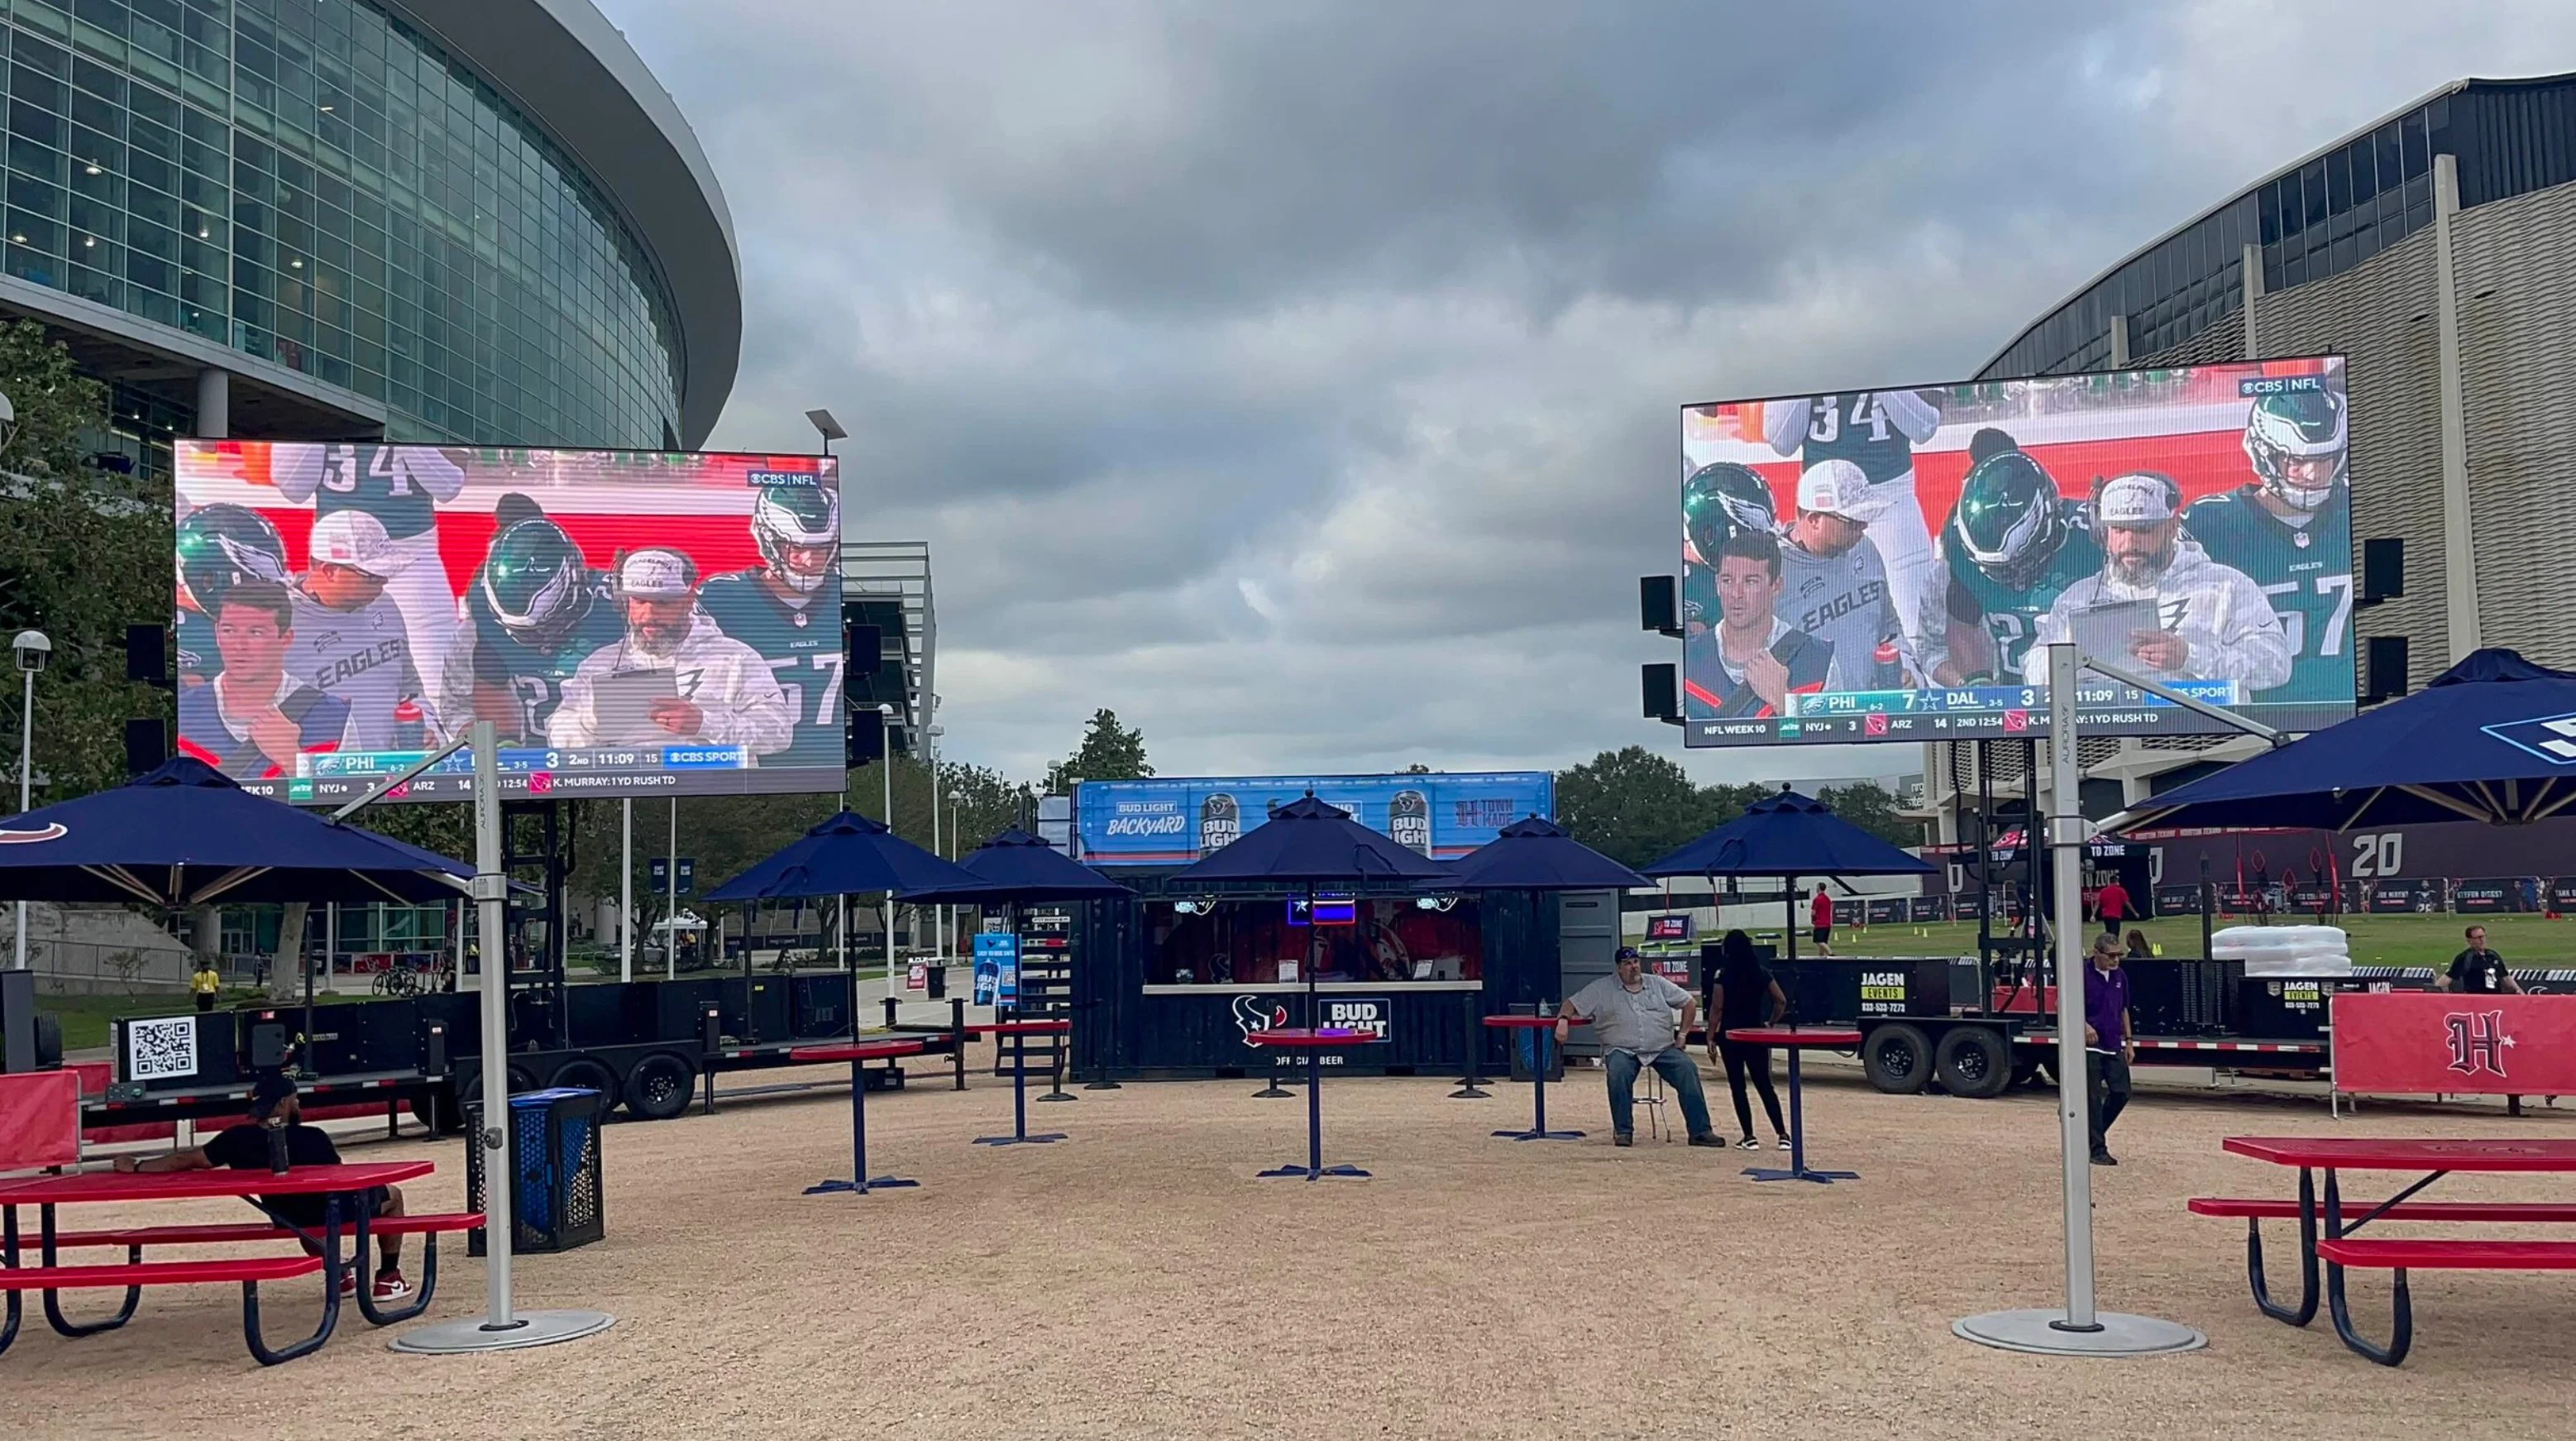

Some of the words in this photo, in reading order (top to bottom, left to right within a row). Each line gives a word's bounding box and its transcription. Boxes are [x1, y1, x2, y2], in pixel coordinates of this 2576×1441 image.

[2254, 381, 2282, 393] CBS
[2292, 377, 2320, 390] NFL
[762, 473, 786, 485] CBS
[792, 474, 817, 486] NFL
[2289, 562, 2323, 572] EAGLES
[1802, 580, 1881, 634] EAGLES
[316, 638, 400, 689] EAGLES
[1828, 696, 1856, 709] PHI
[1903, 693, 1914, 710] 7
[1947, 692, 1978, 706] DAL
[2021, 689, 2035, 706] 3
[2076, 689, 2114, 701] 11:09
[2124, 690, 2139, 700] 15
[1806, 722, 1825, 732] NYJ
[1849, 720, 1857, 730] 3
[1891, 719, 1912, 730] ARZ
[1934, 719, 1947, 728] 14
[1957, 718, 1976, 727] 2ND
[1978, 717, 2003, 727] 12:54
[2095, 713, 2110, 723] YD
[2113, 713, 2143, 723] RUSH
[2143, 714, 2158, 723] TD
[1704, 726, 1725, 735] NFL
[1725, 725, 1754, 735] WEEK
[1755, 725, 1766, 734] 10
[346, 757, 375, 769] PHI
[546, 752, 559, 768] 3
[569, 754, 589, 766] 2ND
[599, 752, 634, 765] 11:09
[645, 754, 658, 764] 15
[681, 751, 704, 763] CBS
[319, 783, 340, 793] NYJ
[367, 783, 375, 792] 3
[413, 780, 435, 792] ARZ
[458, 780, 471, 790] 14
[502, 779, 528, 788] 12:54
[618, 776, 632, 786] YD
[633, 776, 662, 786] RUSH
[662, 776, 676, 785] TD
[260, 785, 274, 795] 10
[1119, 803, 1141, 813] BUD
[1142, 802, 1174, 812] LIGHT
[1482, 798, 1514, 812] TOWN
[1204, 820, 1236, 833] BUD
[1393, 817, 1424, 831] BUD
[2091, 845, 2102, 857] TD
[2104, 845, 2125, 856] ZONE
[2352, 833, 2402, 877] 20
[1672, 961, 1688, 973] ZONE
[1861, 973, 1905, 986] JAGEN
[1868, 988, 1899, 998] EVENTS
[2284, 982, 2318, 991] JAGEN
[1331, 1003, 1378, 1021] BUD
[2444, 1010, 2507, 1078] H
[1320, 1056, 1343, 1065] BEER
